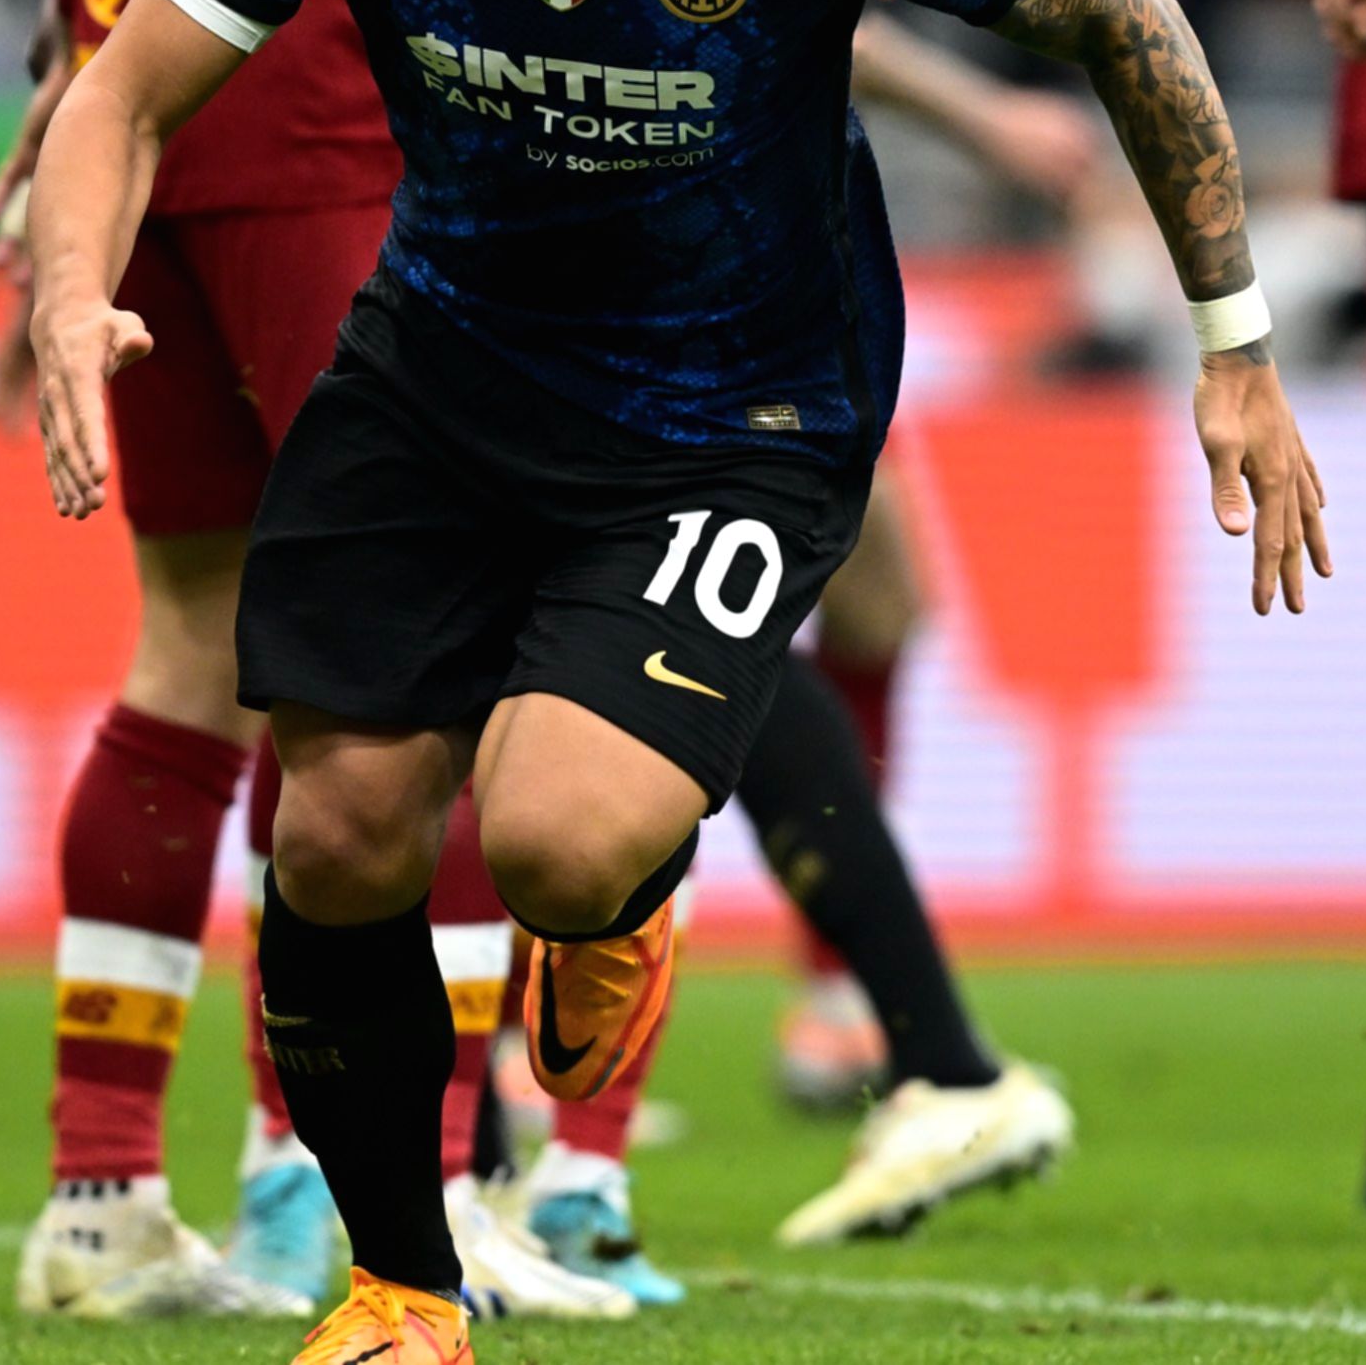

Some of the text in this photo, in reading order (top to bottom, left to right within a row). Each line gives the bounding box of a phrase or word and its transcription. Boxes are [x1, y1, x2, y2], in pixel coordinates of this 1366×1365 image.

[405, 31, 716, 112] $INTER
[422, 69, 715, 146] FAN TOKEN
[526, 143, 715, 173] by socios.com
[642, 509, 784, 639] 10
